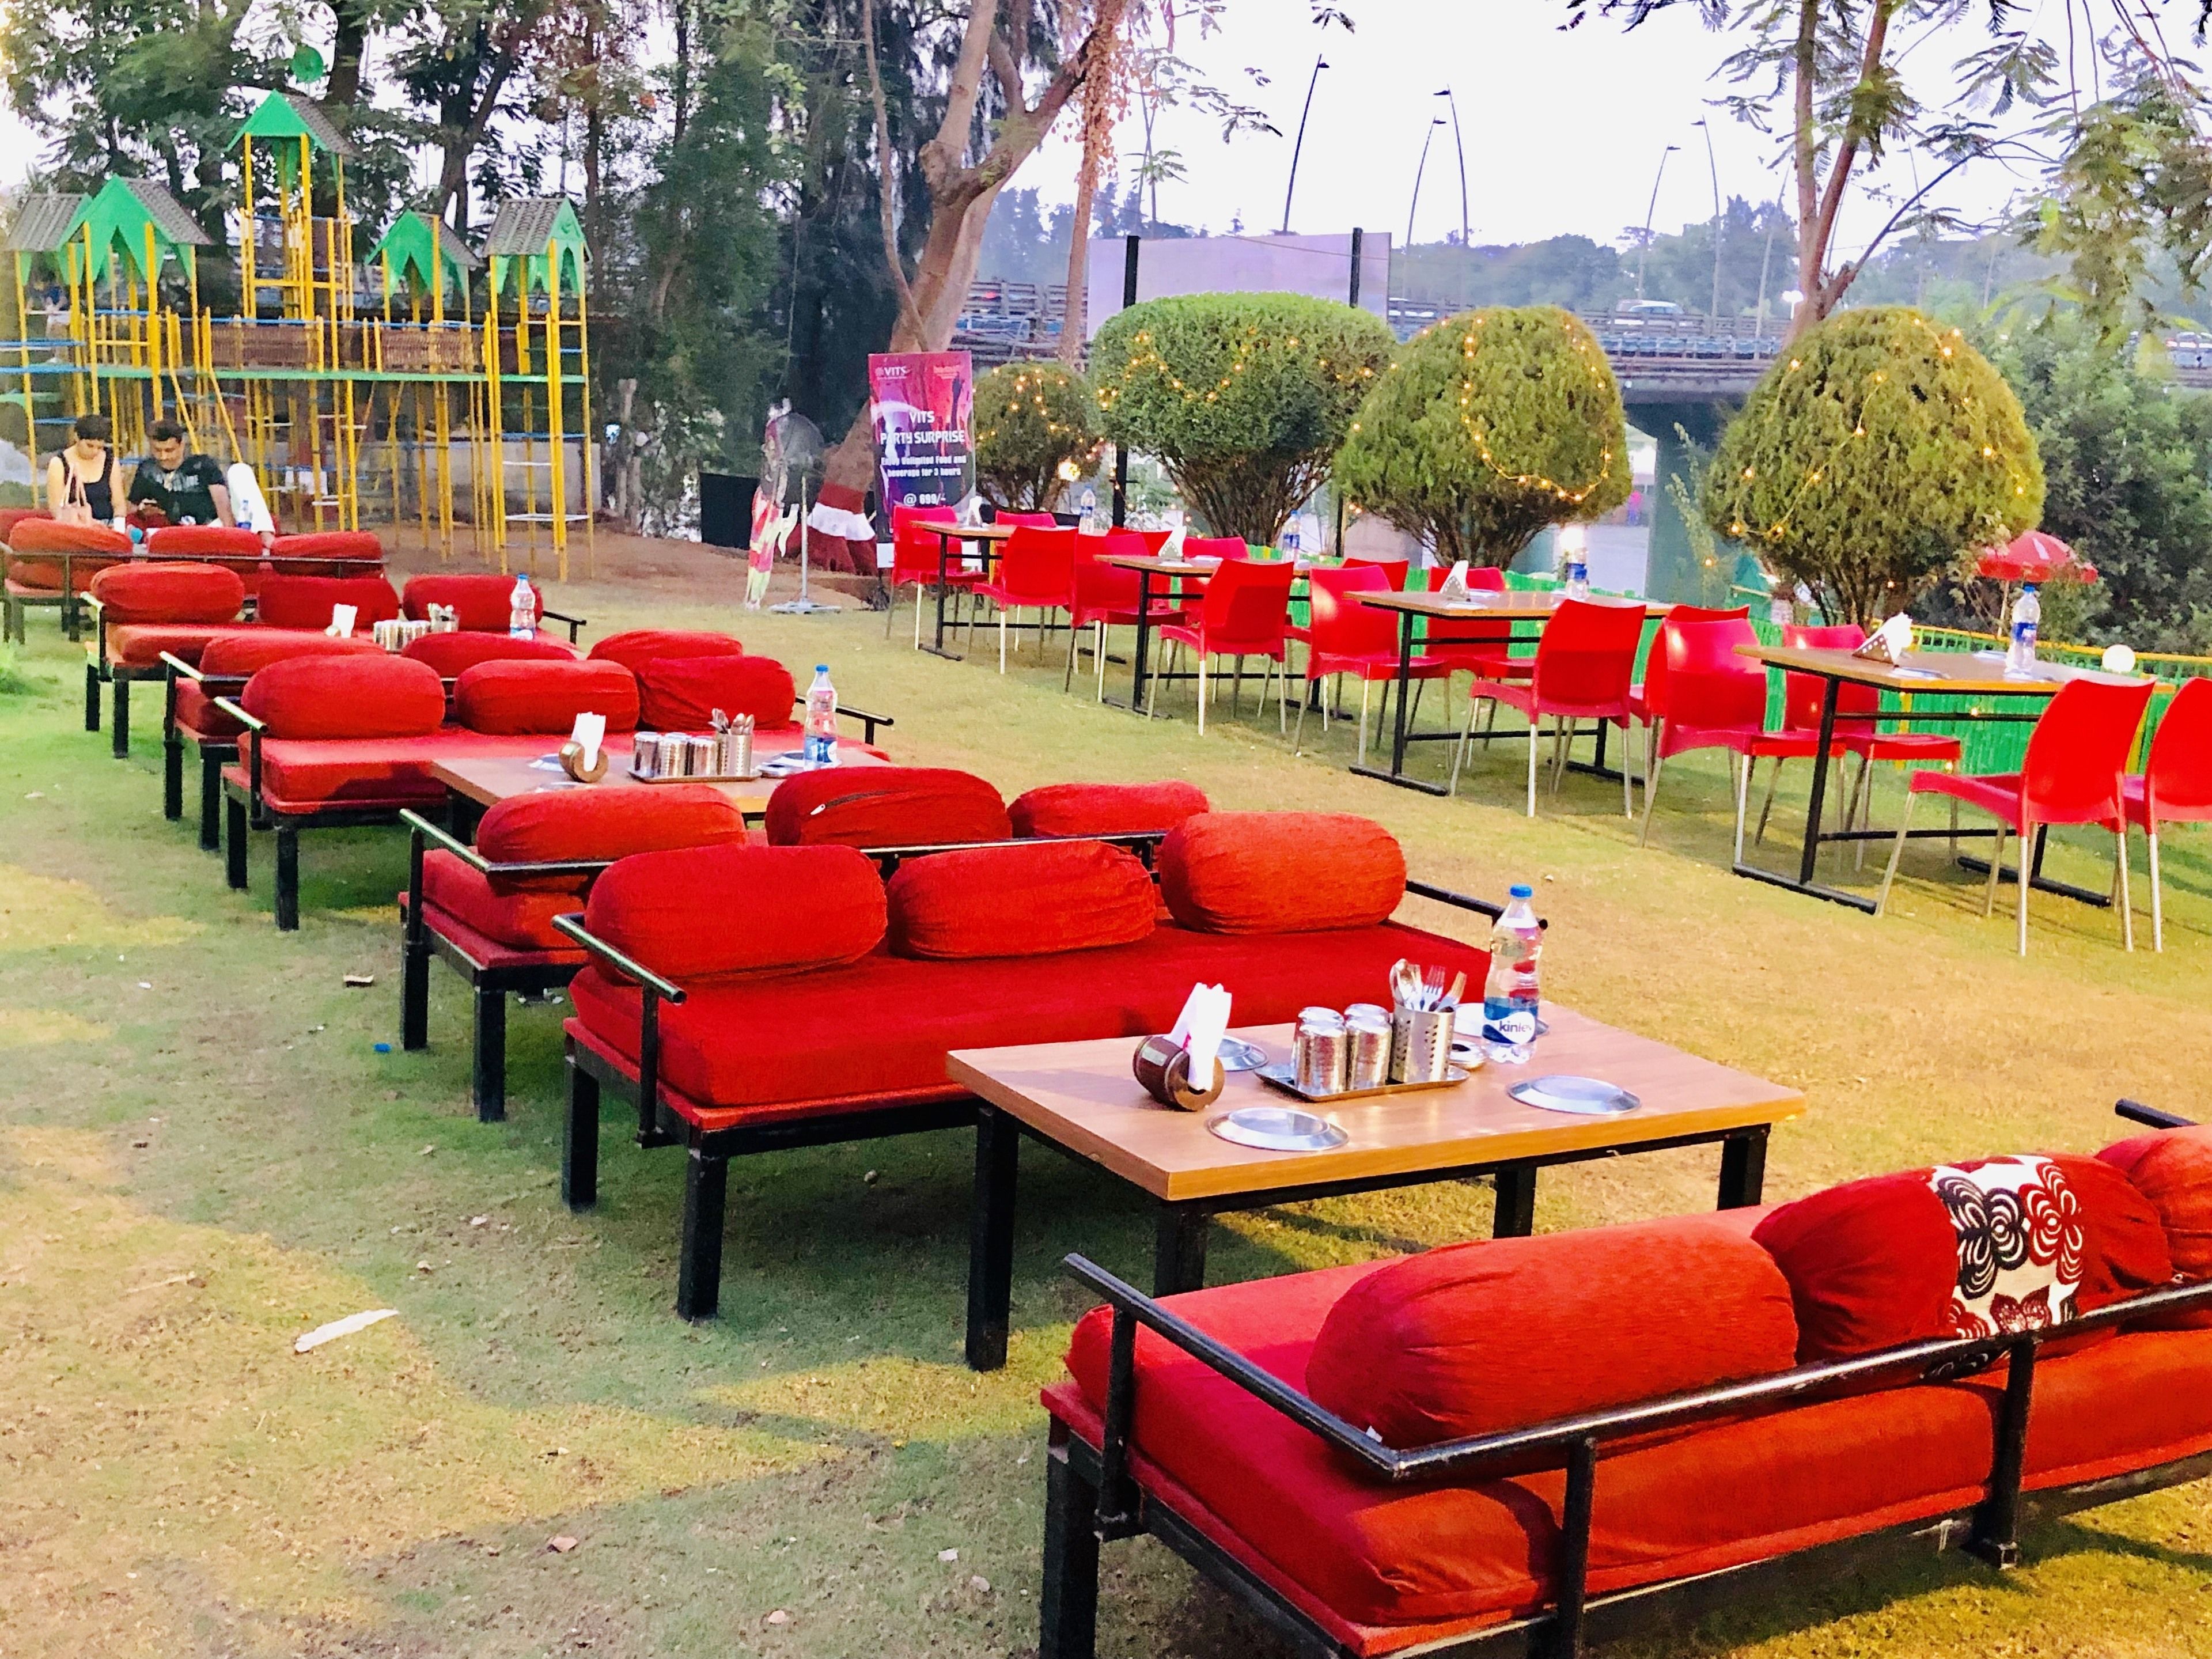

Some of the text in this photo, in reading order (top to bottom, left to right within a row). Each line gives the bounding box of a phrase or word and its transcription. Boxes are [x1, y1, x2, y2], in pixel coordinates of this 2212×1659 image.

[909, 410, 935, 423] VITS
[914, 430, 965, 444] SURPRISE
[953, 454, 967, 464] and
[921, 468, 933, 476] for
[934, 468, 939, 476] 3
[940, 468, 961, 476] hours
[903, 493, 917, 507] @
